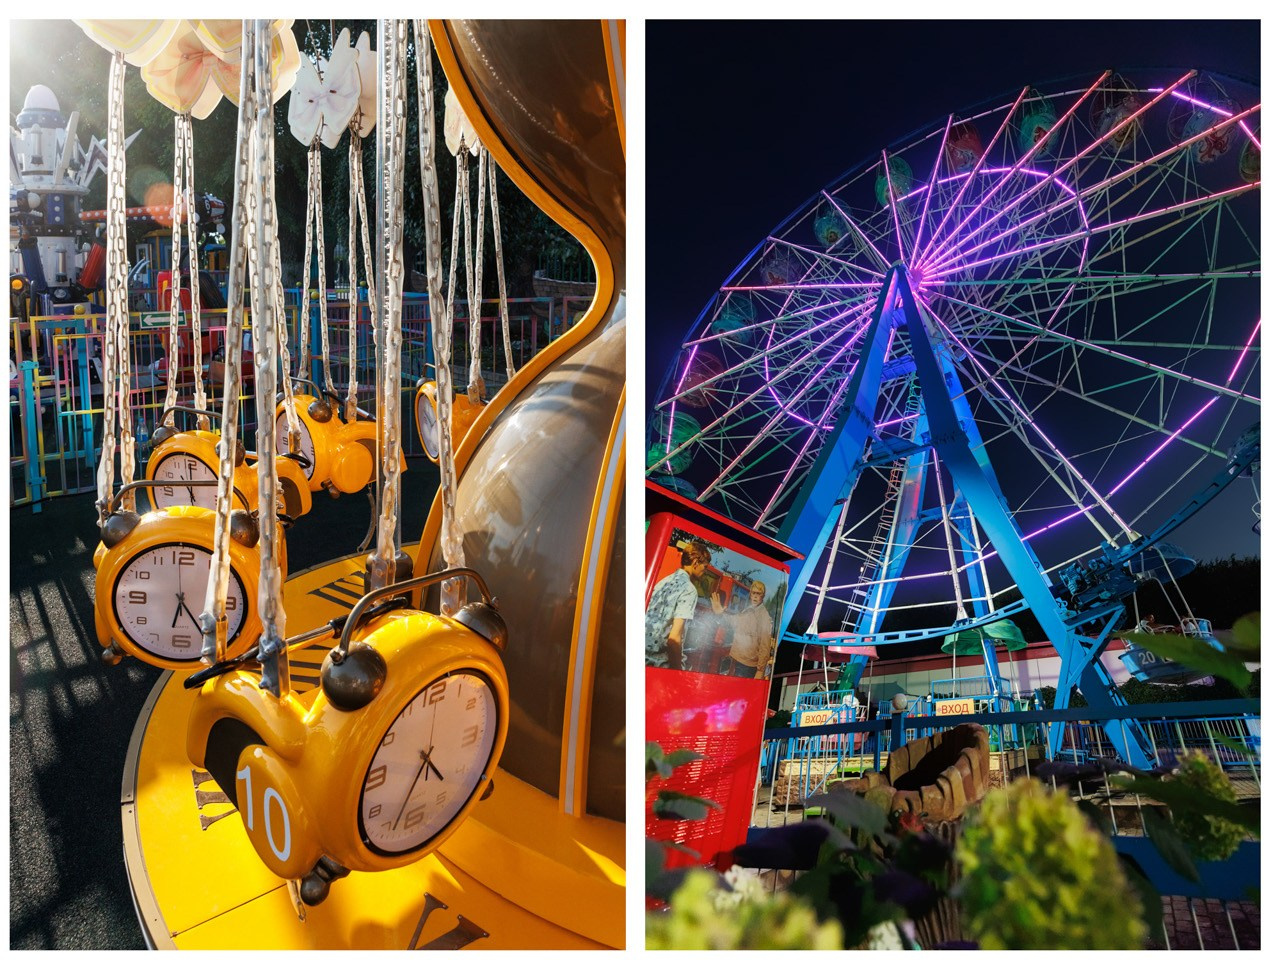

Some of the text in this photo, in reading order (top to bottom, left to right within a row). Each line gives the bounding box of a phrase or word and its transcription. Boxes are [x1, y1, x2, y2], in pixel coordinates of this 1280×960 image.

[184, 459, 197, 471] 12
[153, 556, 163, 566] 11
[172, 551, 195, 566] 12
[135, 570, 150, 580] 10
[128, 590, 147, 605] 9
[136, 616, 147, 626] 8
[149, 632, 160, 642] 7
[172, 634, 192, 649] 6
[1138, 651, 1156, 665] 20
[422, 681, 447, 708] 12
[466, 698, 477, 711] 2
[941, 703, 970, 715] ВХОД
[805, 714, 828, 725] ВХОД
[461, 725, 478, 748] 3
[365, 765, 387, 793] 9
[436, 791, 446, 805] 5
[236, 765, 291, 862] 10
[368, 804, 382, 819] 8
[404, 803, 427, 830] 6
